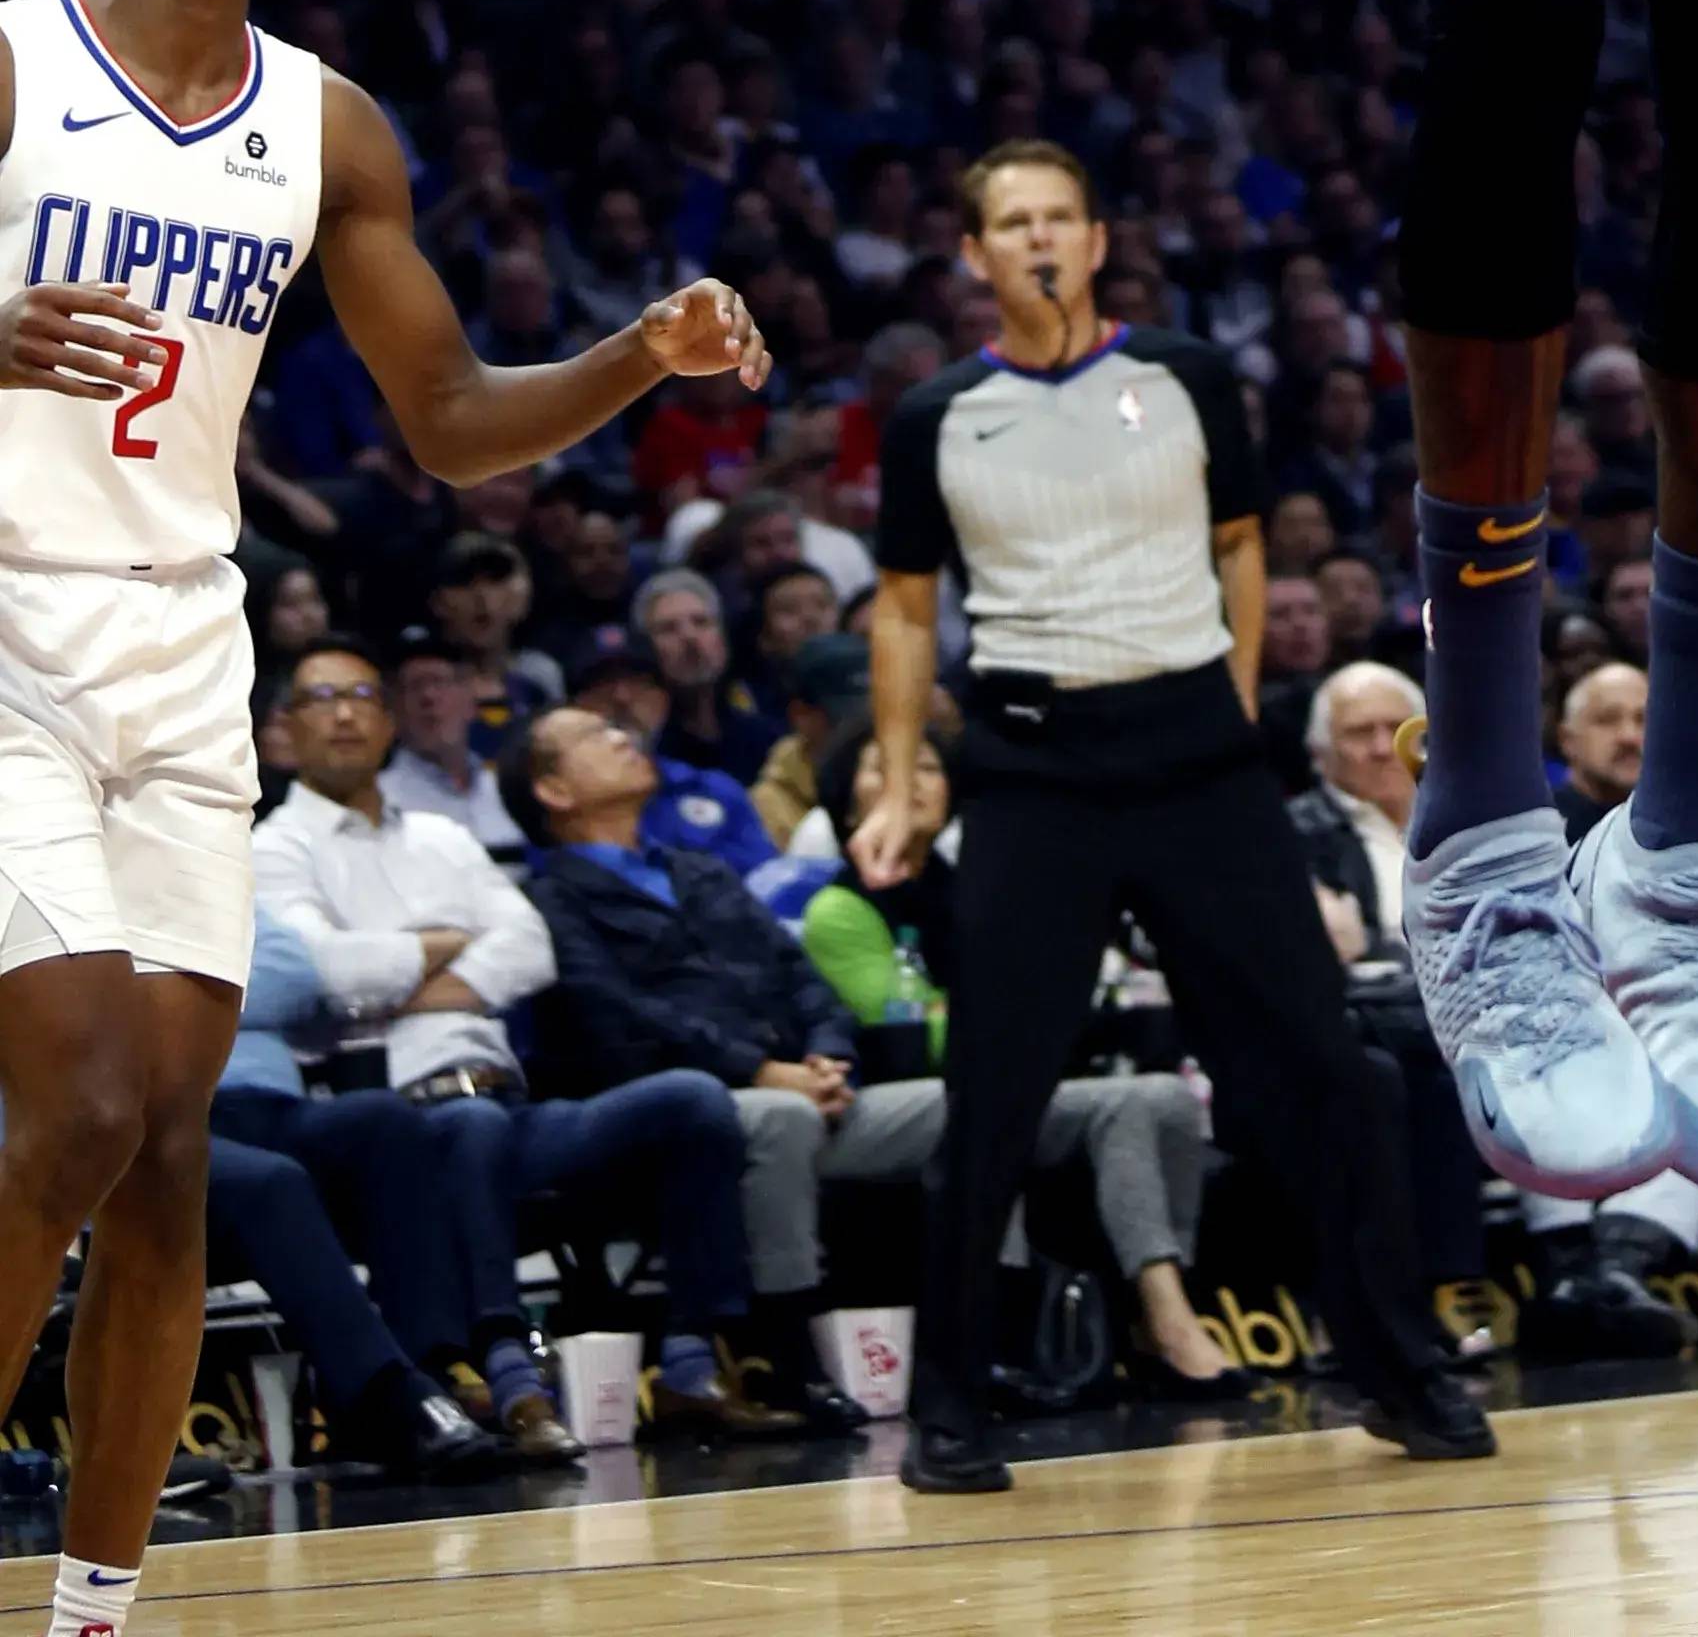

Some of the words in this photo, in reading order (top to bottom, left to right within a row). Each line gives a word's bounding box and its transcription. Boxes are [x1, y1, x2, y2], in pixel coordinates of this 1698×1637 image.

[224, 156, 287, 187] bumble
[25, 193, 293, 336] CLIPPERS
[112, 332, 184, 460] 2
